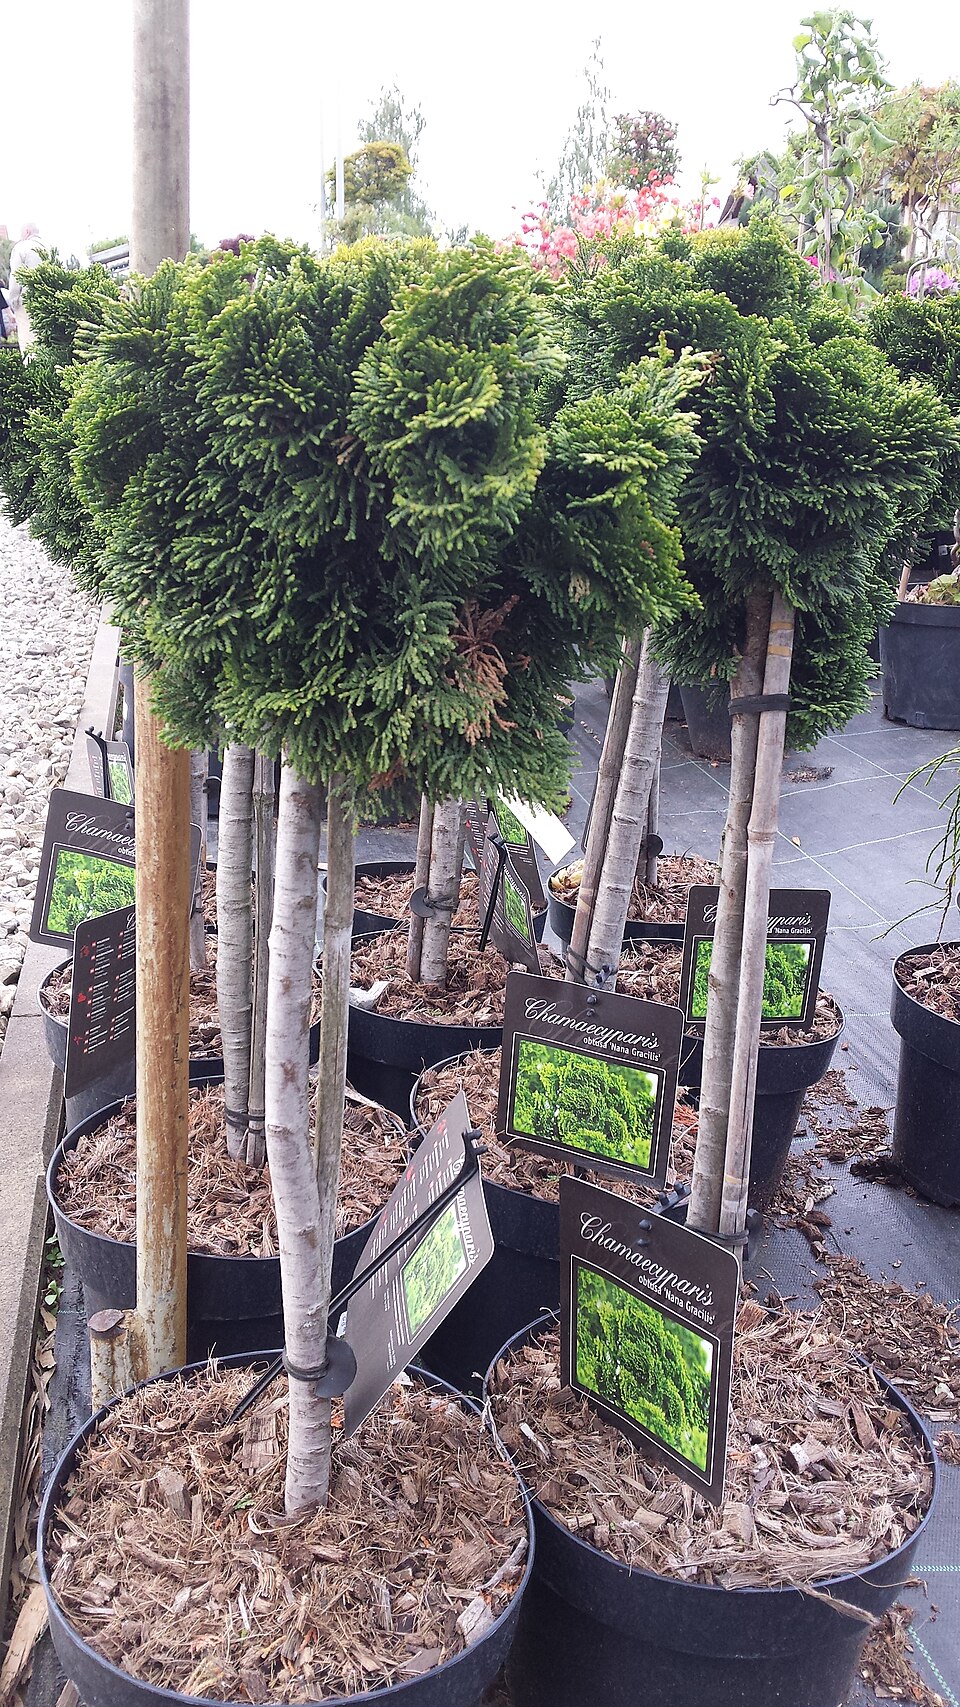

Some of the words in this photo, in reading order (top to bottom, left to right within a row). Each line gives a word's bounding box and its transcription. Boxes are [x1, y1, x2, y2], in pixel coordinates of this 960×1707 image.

[65, 811, 136, 847] Chamaec
[117, 847, 136, 857] obtus
[524, 997, 660, 1049] Chamaecyparis
[583, 1037, 608, 1049] obtusa
[609, 1042, 630, 1055] 'Nana
[631, 1048, 661, 1062] Gracilis'
[580, 1212, 714, 1306] Chamaecyparis
[638, 1274, 662, 1296] obtusa
[663, 1287, 685, 1308] 'Nana
[686, 1302, 716, 1325] Gracilis'
